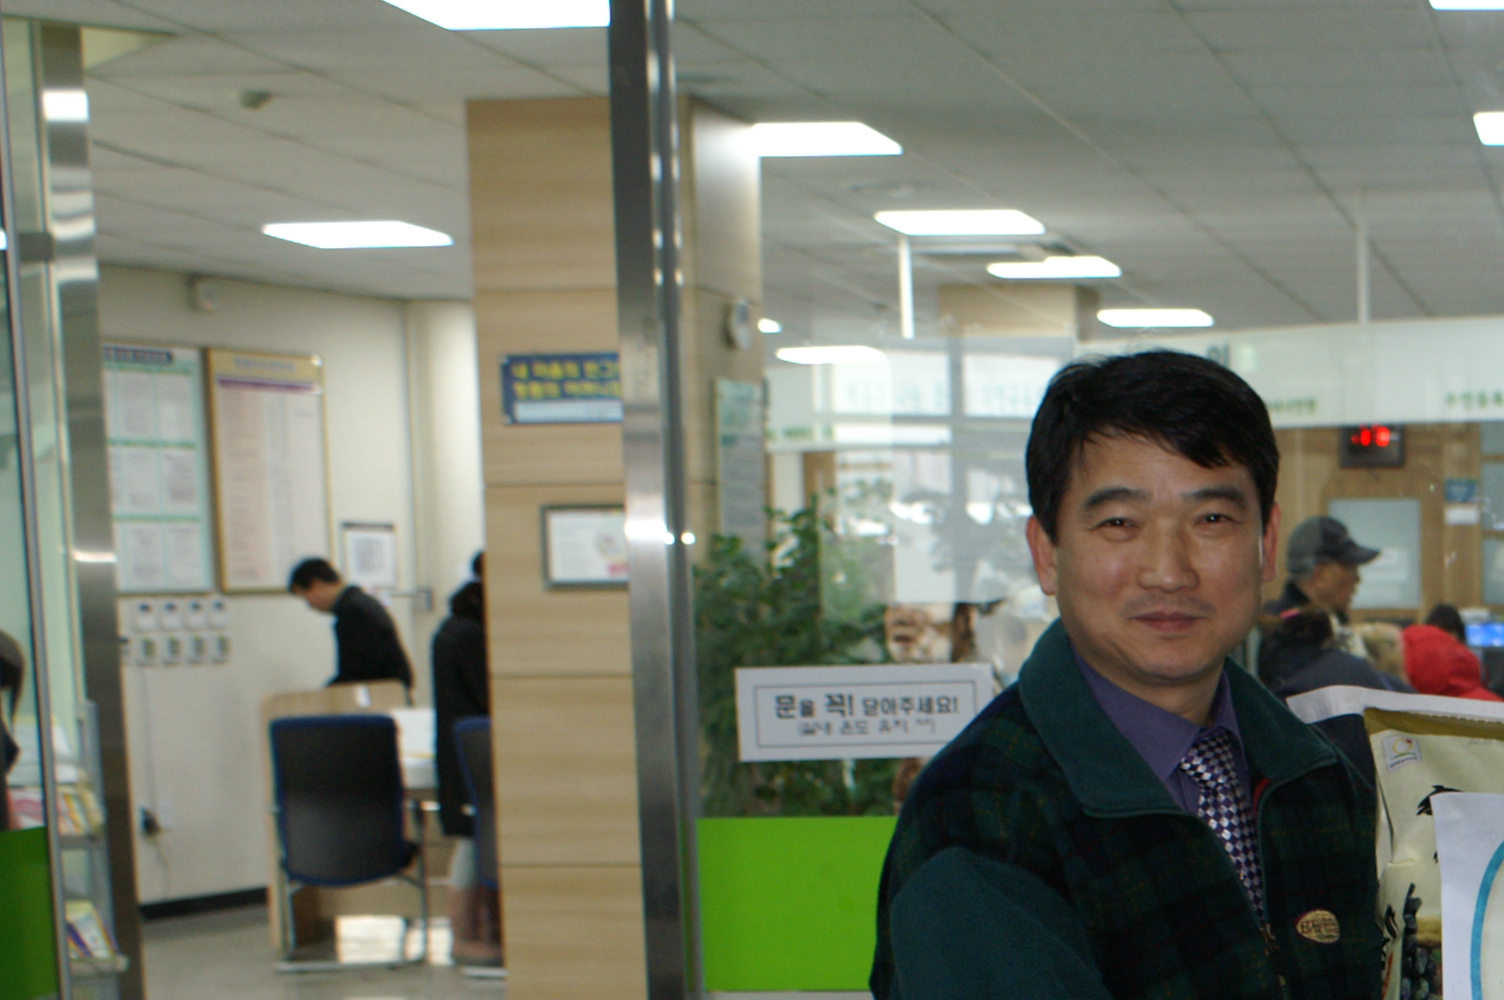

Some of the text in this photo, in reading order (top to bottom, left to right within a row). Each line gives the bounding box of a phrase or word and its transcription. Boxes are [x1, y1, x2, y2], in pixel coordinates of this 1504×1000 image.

[775, 693, 959, 719] 문을 꼭! 닫아주세요!
